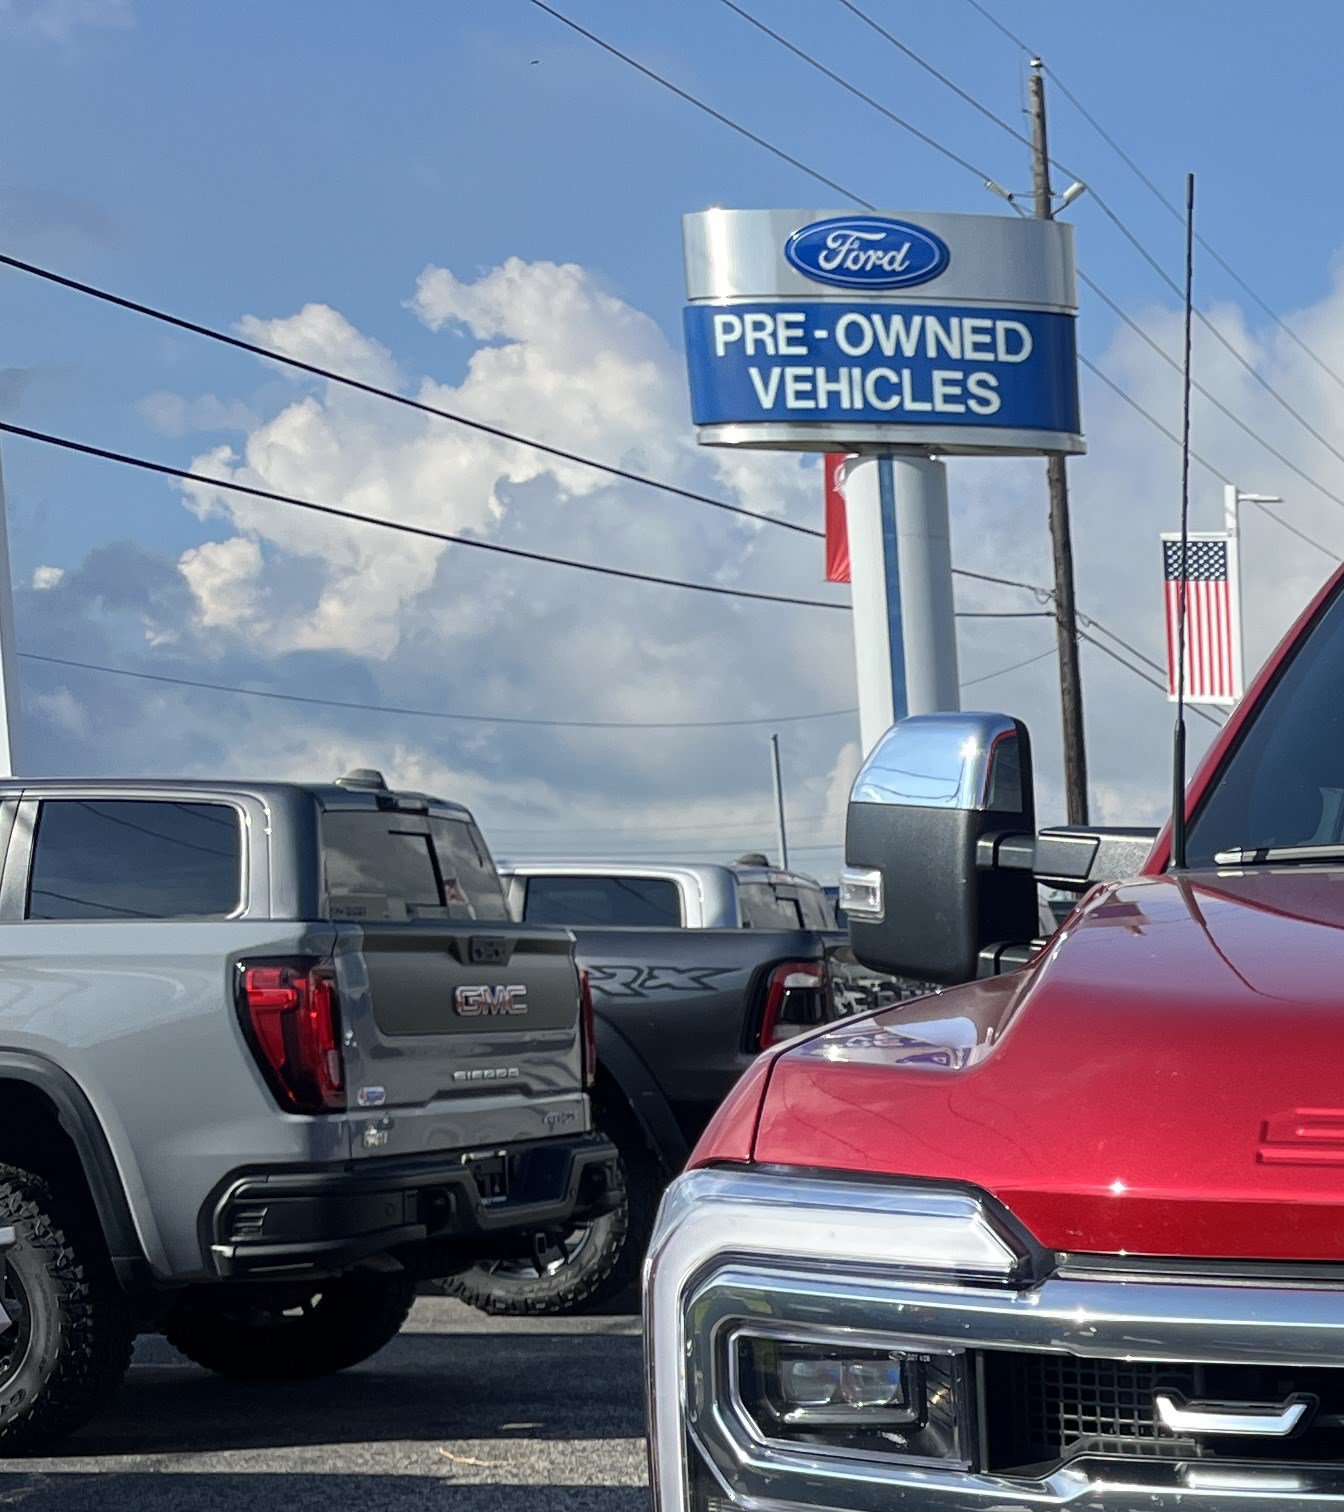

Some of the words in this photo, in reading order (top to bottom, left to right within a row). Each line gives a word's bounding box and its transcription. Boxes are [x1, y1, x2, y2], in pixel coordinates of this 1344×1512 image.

[817, 229, 911, 273] Ford
[748, 366, 1001, 415] VEHICLES
[454, 985, 529, 1016] GMC
[589, 965, 744, 998] RX
